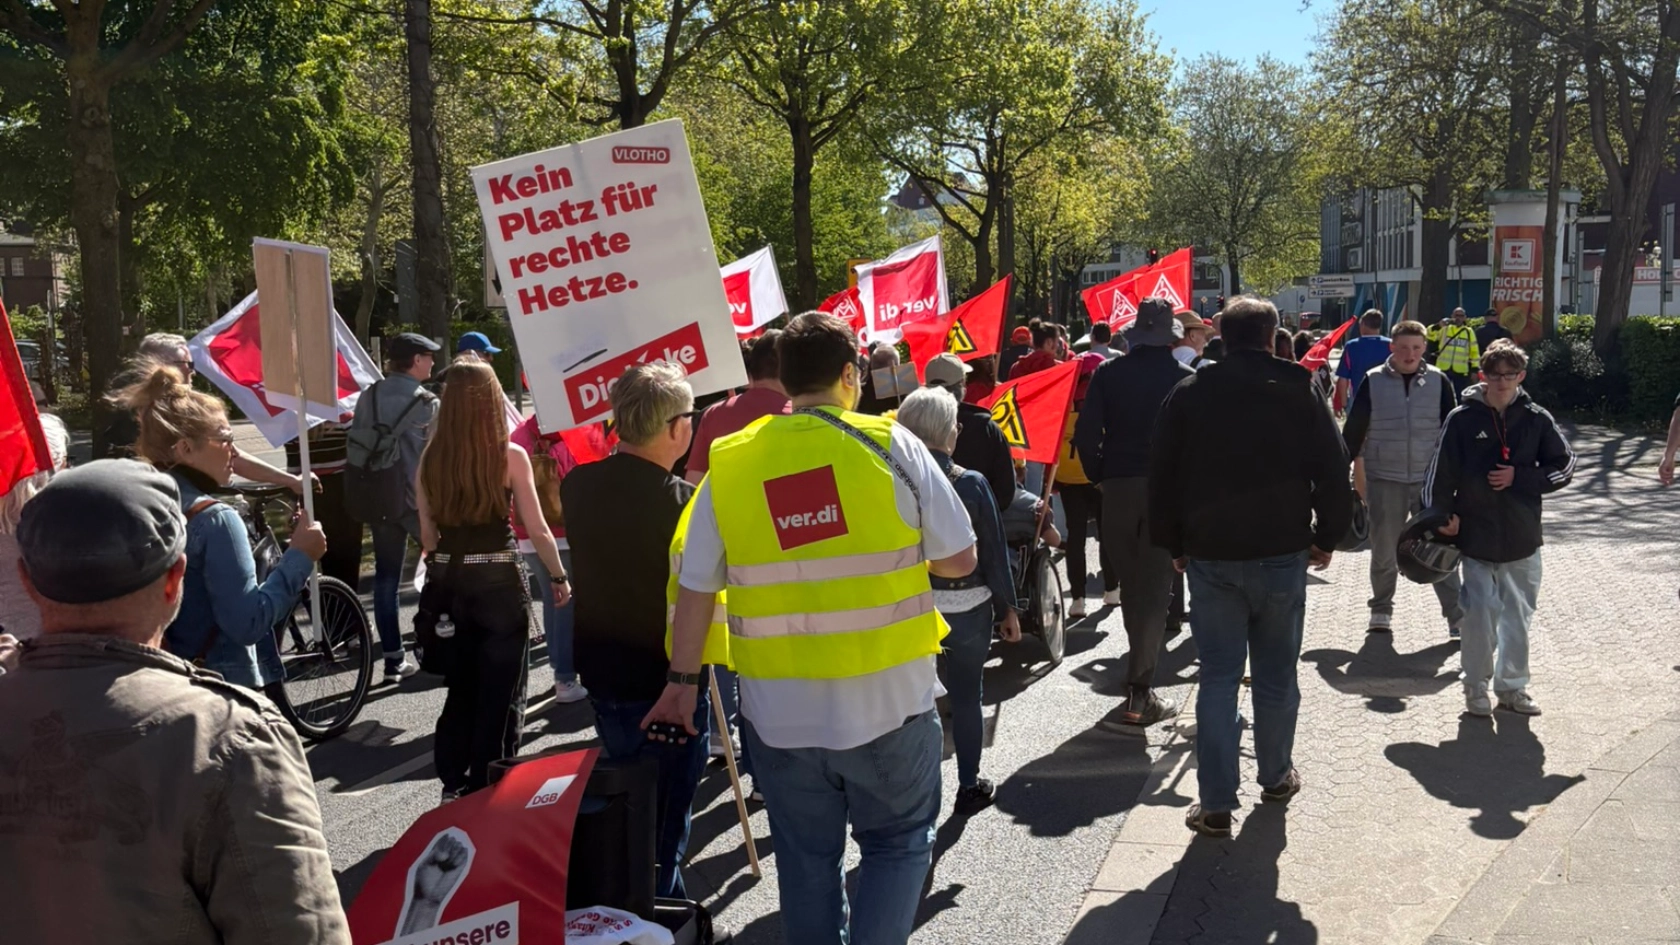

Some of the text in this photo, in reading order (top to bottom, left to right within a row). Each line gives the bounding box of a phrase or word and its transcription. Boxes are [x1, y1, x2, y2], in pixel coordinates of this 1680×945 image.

[613, 149, 667, 162] VLOTHO
[488, 164, 573, 205] Kein
[498, 181, 658, 242] Platz für
[509, 232, 631, 279] rechte
[518, 271, 639, 315] Hetze.
[1494, 276, 1544, 288] RICHTIG
[1492, 288, 1544, 302] FRISCH
[777, 504, 838, 529] ver.di
[532, 792, 559, 806] DGB
[433, 920, 511, 945] sere
